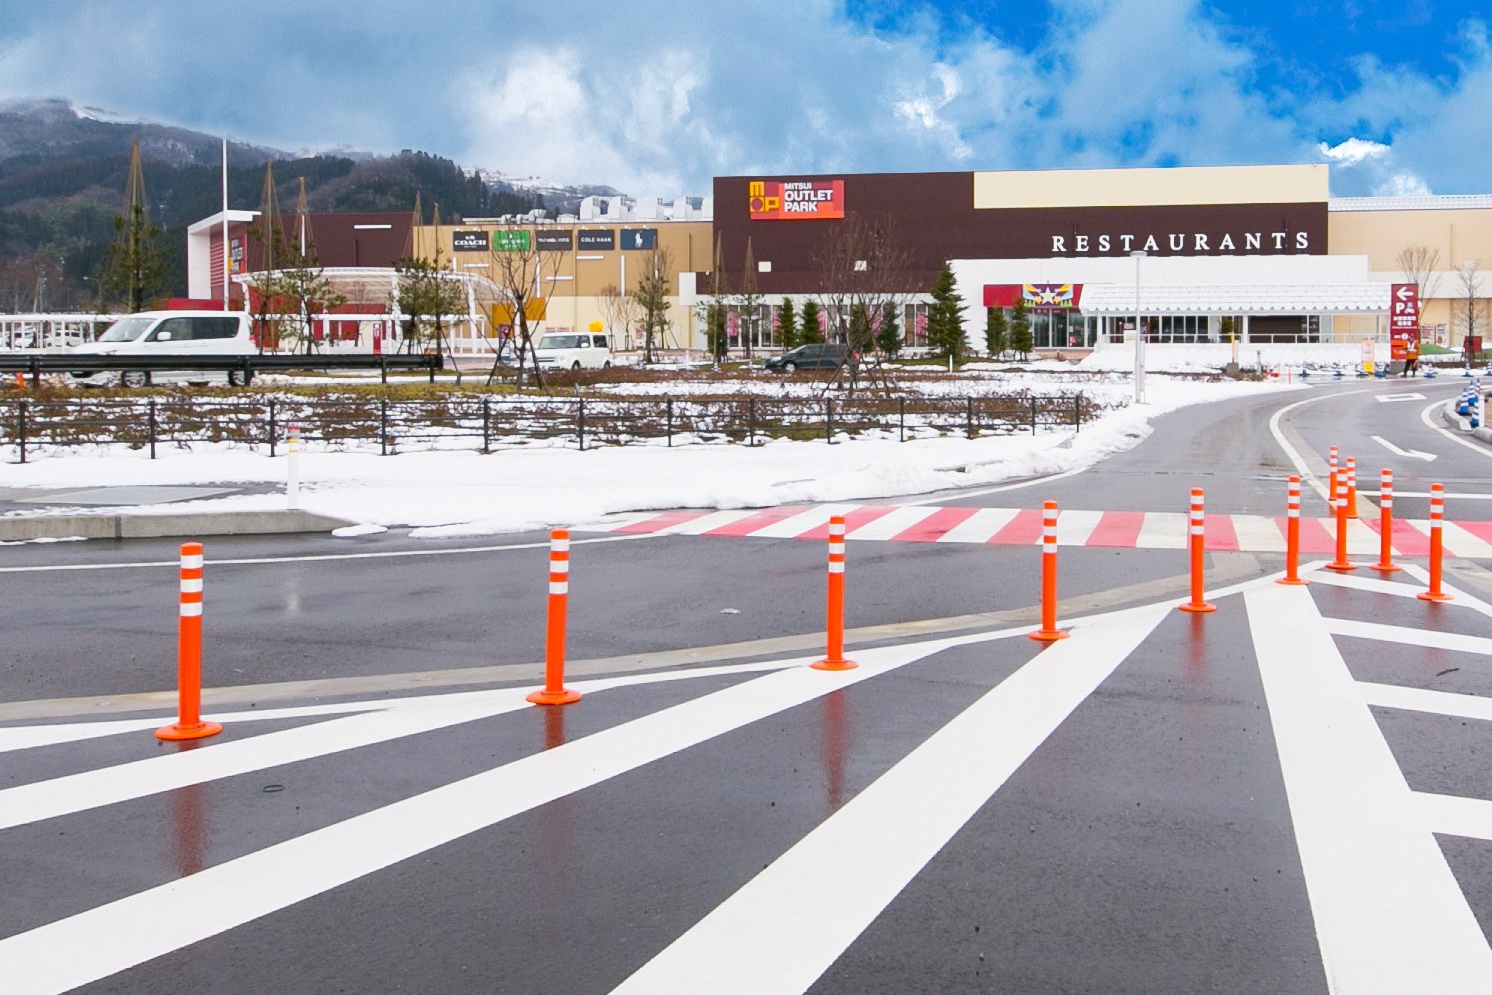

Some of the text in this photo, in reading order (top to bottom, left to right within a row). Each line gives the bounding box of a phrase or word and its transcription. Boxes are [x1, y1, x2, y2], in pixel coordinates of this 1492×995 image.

[783, 182, 812, 190] MITSUI
[783, 189, 833, 201] OUTLET
[783, 201, 818, 213] PARK
[1050, 231, 1310, 253] RESTAURANTS
[1395, 302, 1405, 314] P
